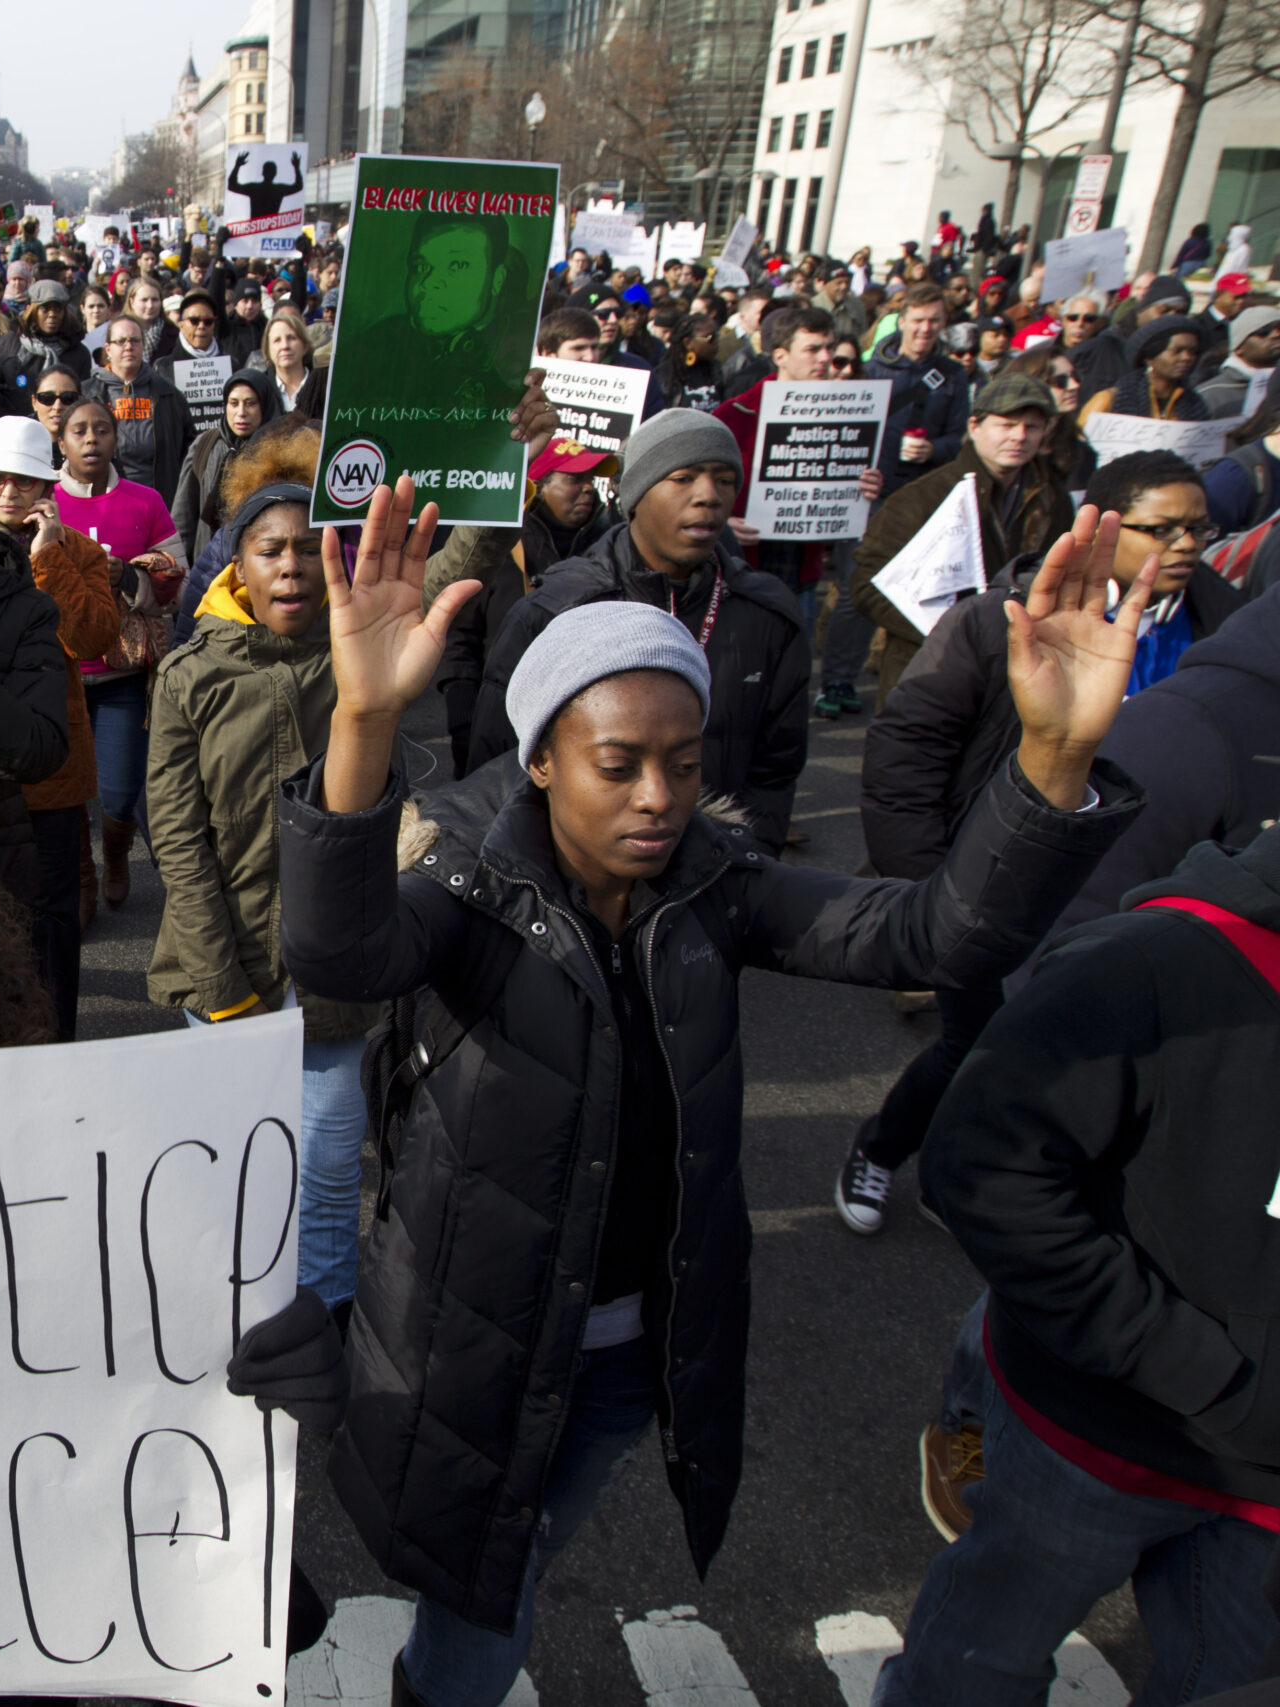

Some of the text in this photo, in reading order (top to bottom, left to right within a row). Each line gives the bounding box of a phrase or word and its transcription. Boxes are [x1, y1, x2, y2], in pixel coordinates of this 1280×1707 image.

[361, 186, 554, 217] BLACK LIVES MATTER
[263, 239, 295, 251] ACLU
[190, 369, 219, 378] Brutality
[546, 371, 627, 390] erguson is
[200, 378, 224, 387] Murder
[543, 384, 629, 405] verywhere!
[785, 390, 873, 404] Ferguson is
[334, 407, 367, 427] MY
[370, 407, 441, 421] HANDS
[443, 407, 487, 421] ARE
[780, 404, 875, 418] Everywhere!
[589, 412, 611, 431] for
[1090, 417, 1170, 442] NEVER
[578, 428, 622, 451] Brown
[786, 426, 861, 442] Justice for
[770, 444, 869, 460] Michael Brown
[331, 462, 380, 487] NAN
[765, 462, 794, 478] and
[796, 462, 824, 477] Eric
[445, 470, 517, 490] BROWN
[764, 487, 862, 502] Police Brutality
[776, 504, 849, 517] and Murder
[773, 519, 850, 534] MUST STOP!
